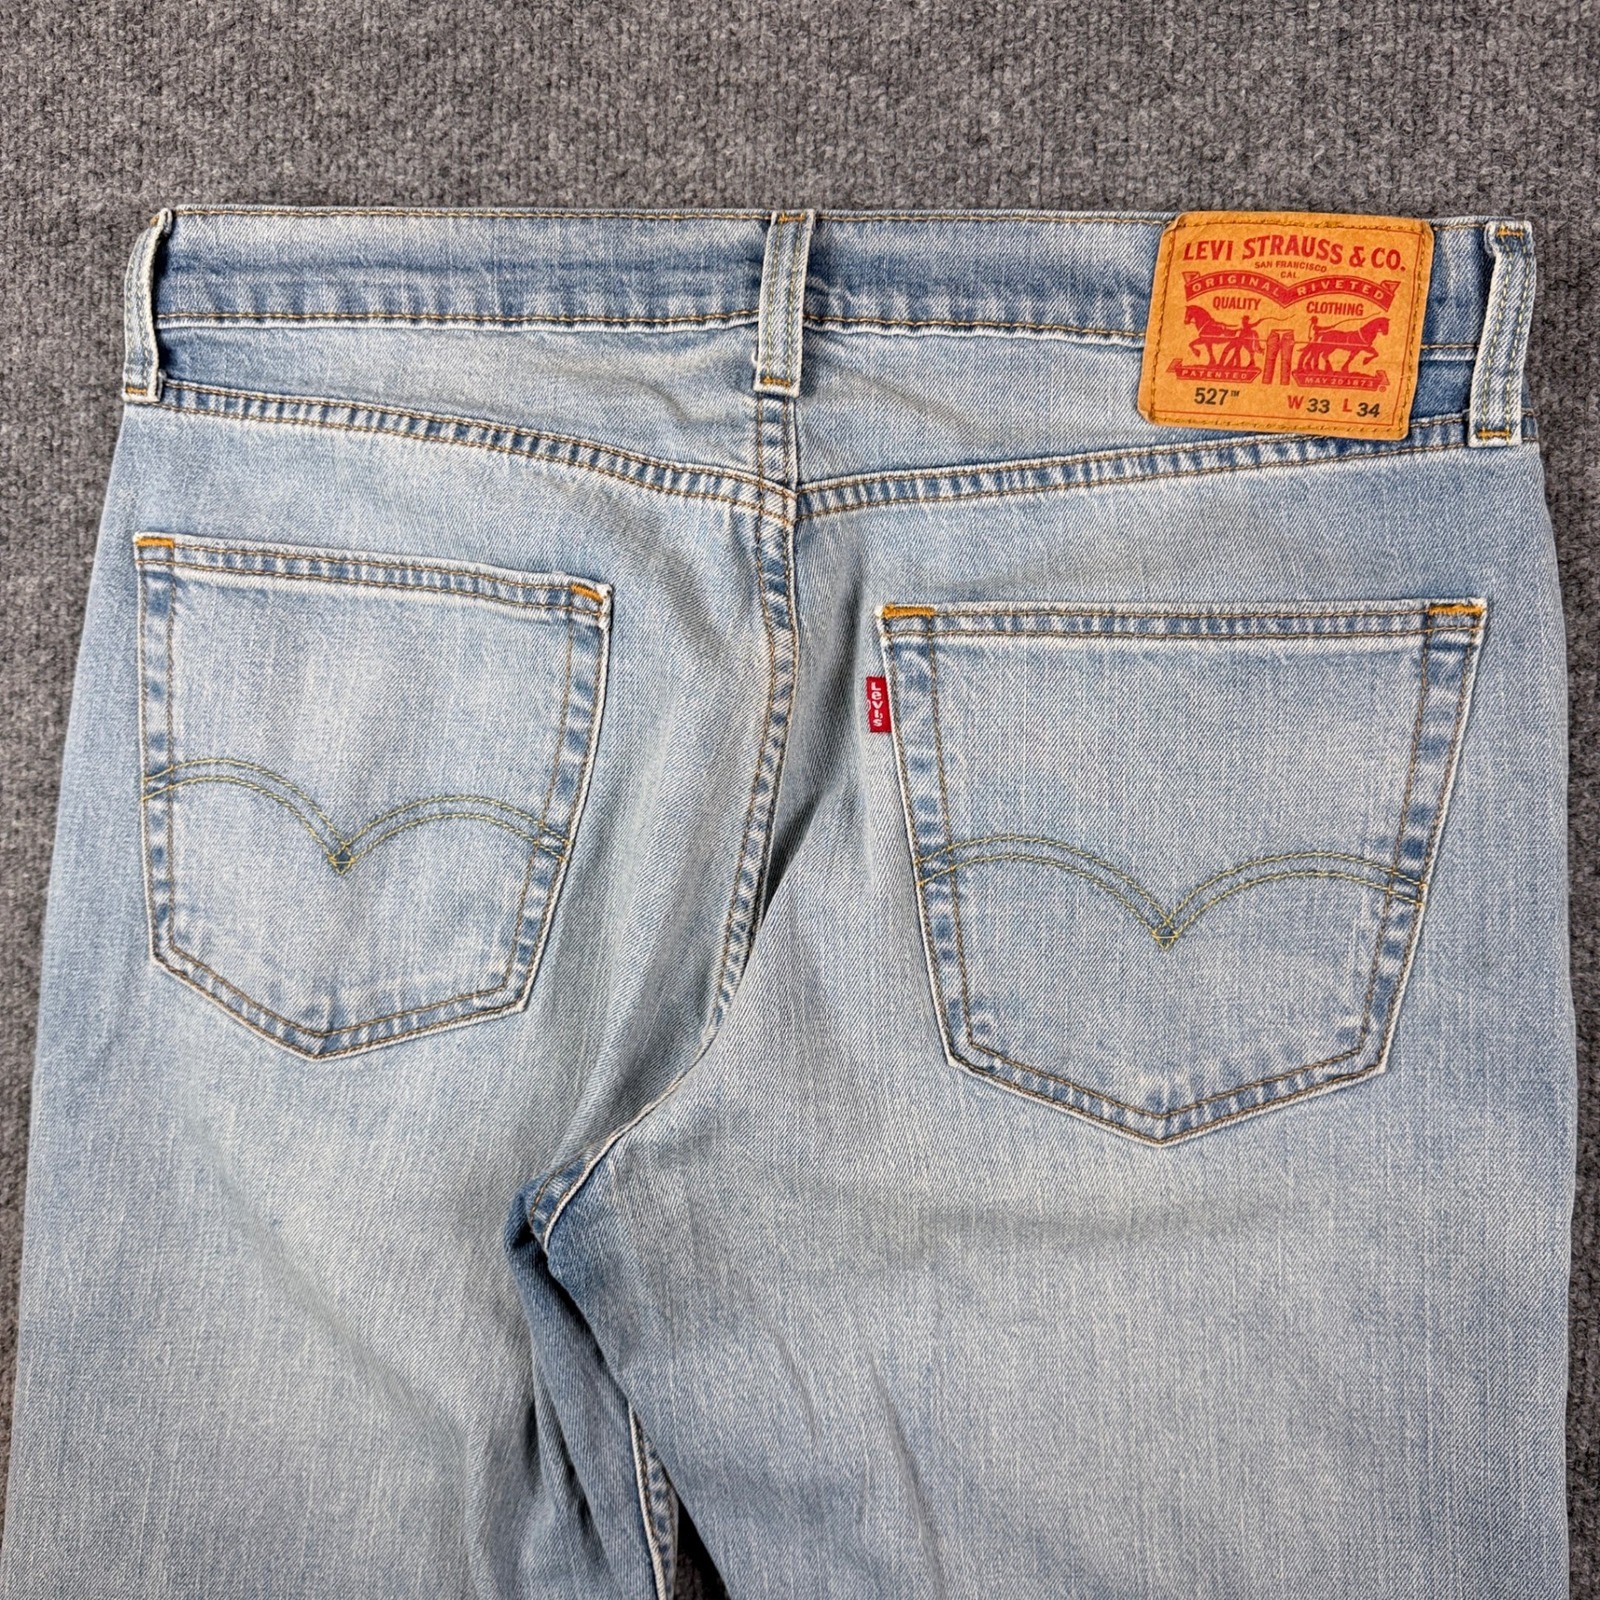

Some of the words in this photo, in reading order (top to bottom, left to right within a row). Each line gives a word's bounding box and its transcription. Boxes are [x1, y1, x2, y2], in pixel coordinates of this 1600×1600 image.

[1182, 240, 1234, 261] LEVI
[1242, 234, 1344, 265] STRAUSS
[1348, 245, 1366, 268] &
[1371, 247, 1406, 272] CO.
[1254, 260, 1273, 269] SAN
[1275, 260, 1327, 273] FRANCISCO
[1192, 275, 1280, 297] ORIGINAL
[1296, 280, 1385, 300] RIVETED
[1212, 296, 1261, 311] QUALITY
[1306, 301, 1364, 317] CLOTHING
[1181, 369, 1248, 380] PATENTED
[1304, 376, 1328, 385] MAY
[1330, 378, 1345, 386] 20
[1346, 379, 1375, 388] 1873
[1306, 398, 1330, 414] 33
[1356, 402, 1380, 418] 34
